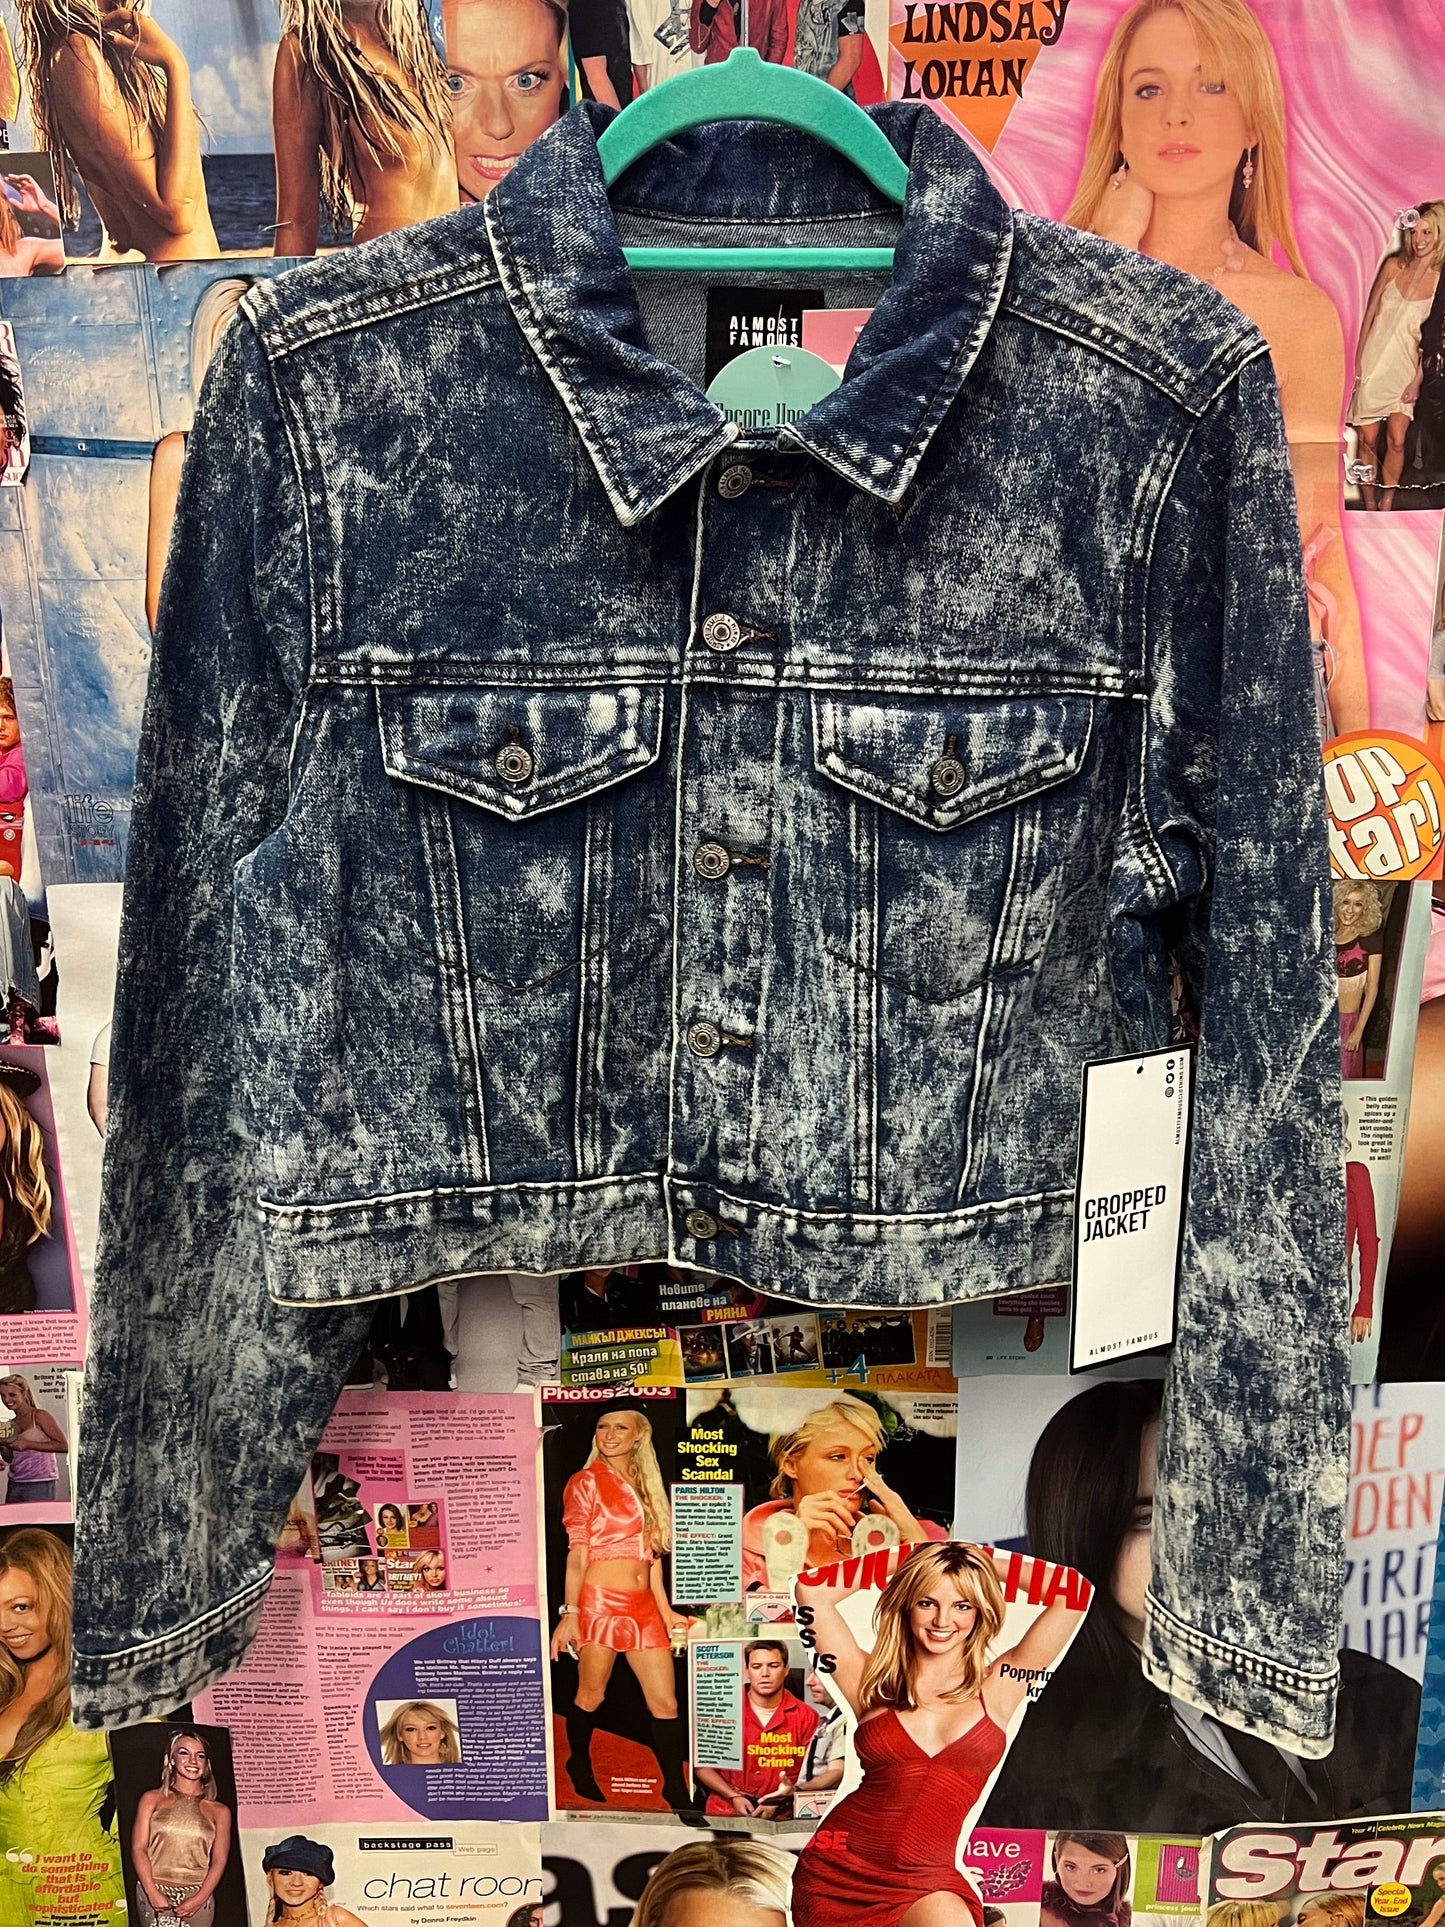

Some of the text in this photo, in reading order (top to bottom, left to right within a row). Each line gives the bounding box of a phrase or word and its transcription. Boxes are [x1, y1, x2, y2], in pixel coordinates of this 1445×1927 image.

[902, 0, 1070, 46] LINDSAY
[901, 58, 1028, 100] LOHAN
[730, 316, 798, 332] ALMOST
[730, 331, 798, 346] FAMOUS
[1084, 1185, 1166, 1220] CROPPED
[1084, 1210, 1150, 1242] JACKET
[660, 1283, 705, 1296] Новите
[662, 1296, 727, 1310] планове на
[706, 1308, 748, 1321] РИЯНА
[572, 1328, 666, 1346] МАЙКЪЛ ДЖЕКСЪН
[1089, 1332, 1158, 1356] ALMOST FAMOUS
[572, 1347, 657, 1366] Краля на попа
[572, 1362, 648, 1382] става на 50!
[876, 1370, 940, 1384] ПЛАКАТА
[691, 1428, 724, 1440] Most
[678, 1442, 737, 1456] Shocking
[696, 1456, 719, 1467] Sex
[682, 1469, 733, 1481] Scandal
[387, 1559, 415, 1569] Star
[454, 1588, 496, 1596] business
[476, 1594, 507, 1602] absurd
[460, 1622, 496, 1640] Idol
[443, 1636, 514, 1654] Chatter!
[760, 1732, 792, 1744] Most
[747, 1744, 805, 1757] Shocking
[758, 1756, 794, 1768] Crime
[1378, 1822, 1406, 1832] Celebrity
[43, 1853, 76, 1863] want
[80, 1853, 92, 1861] to
[1214, 1830, 1445, 1899] Star
[22, 1862, 109, 1873] do something
[46, 1873, 86, 1883] that is
[35, 1882, 101, 1893] affordable
[364, 1872, 452, 1898] chat
[58, 1894, 80, 1903] but
[28, 1900, 114, 1913] sophisticated
[446, 1902, 508, 1910] seventeen.com?
